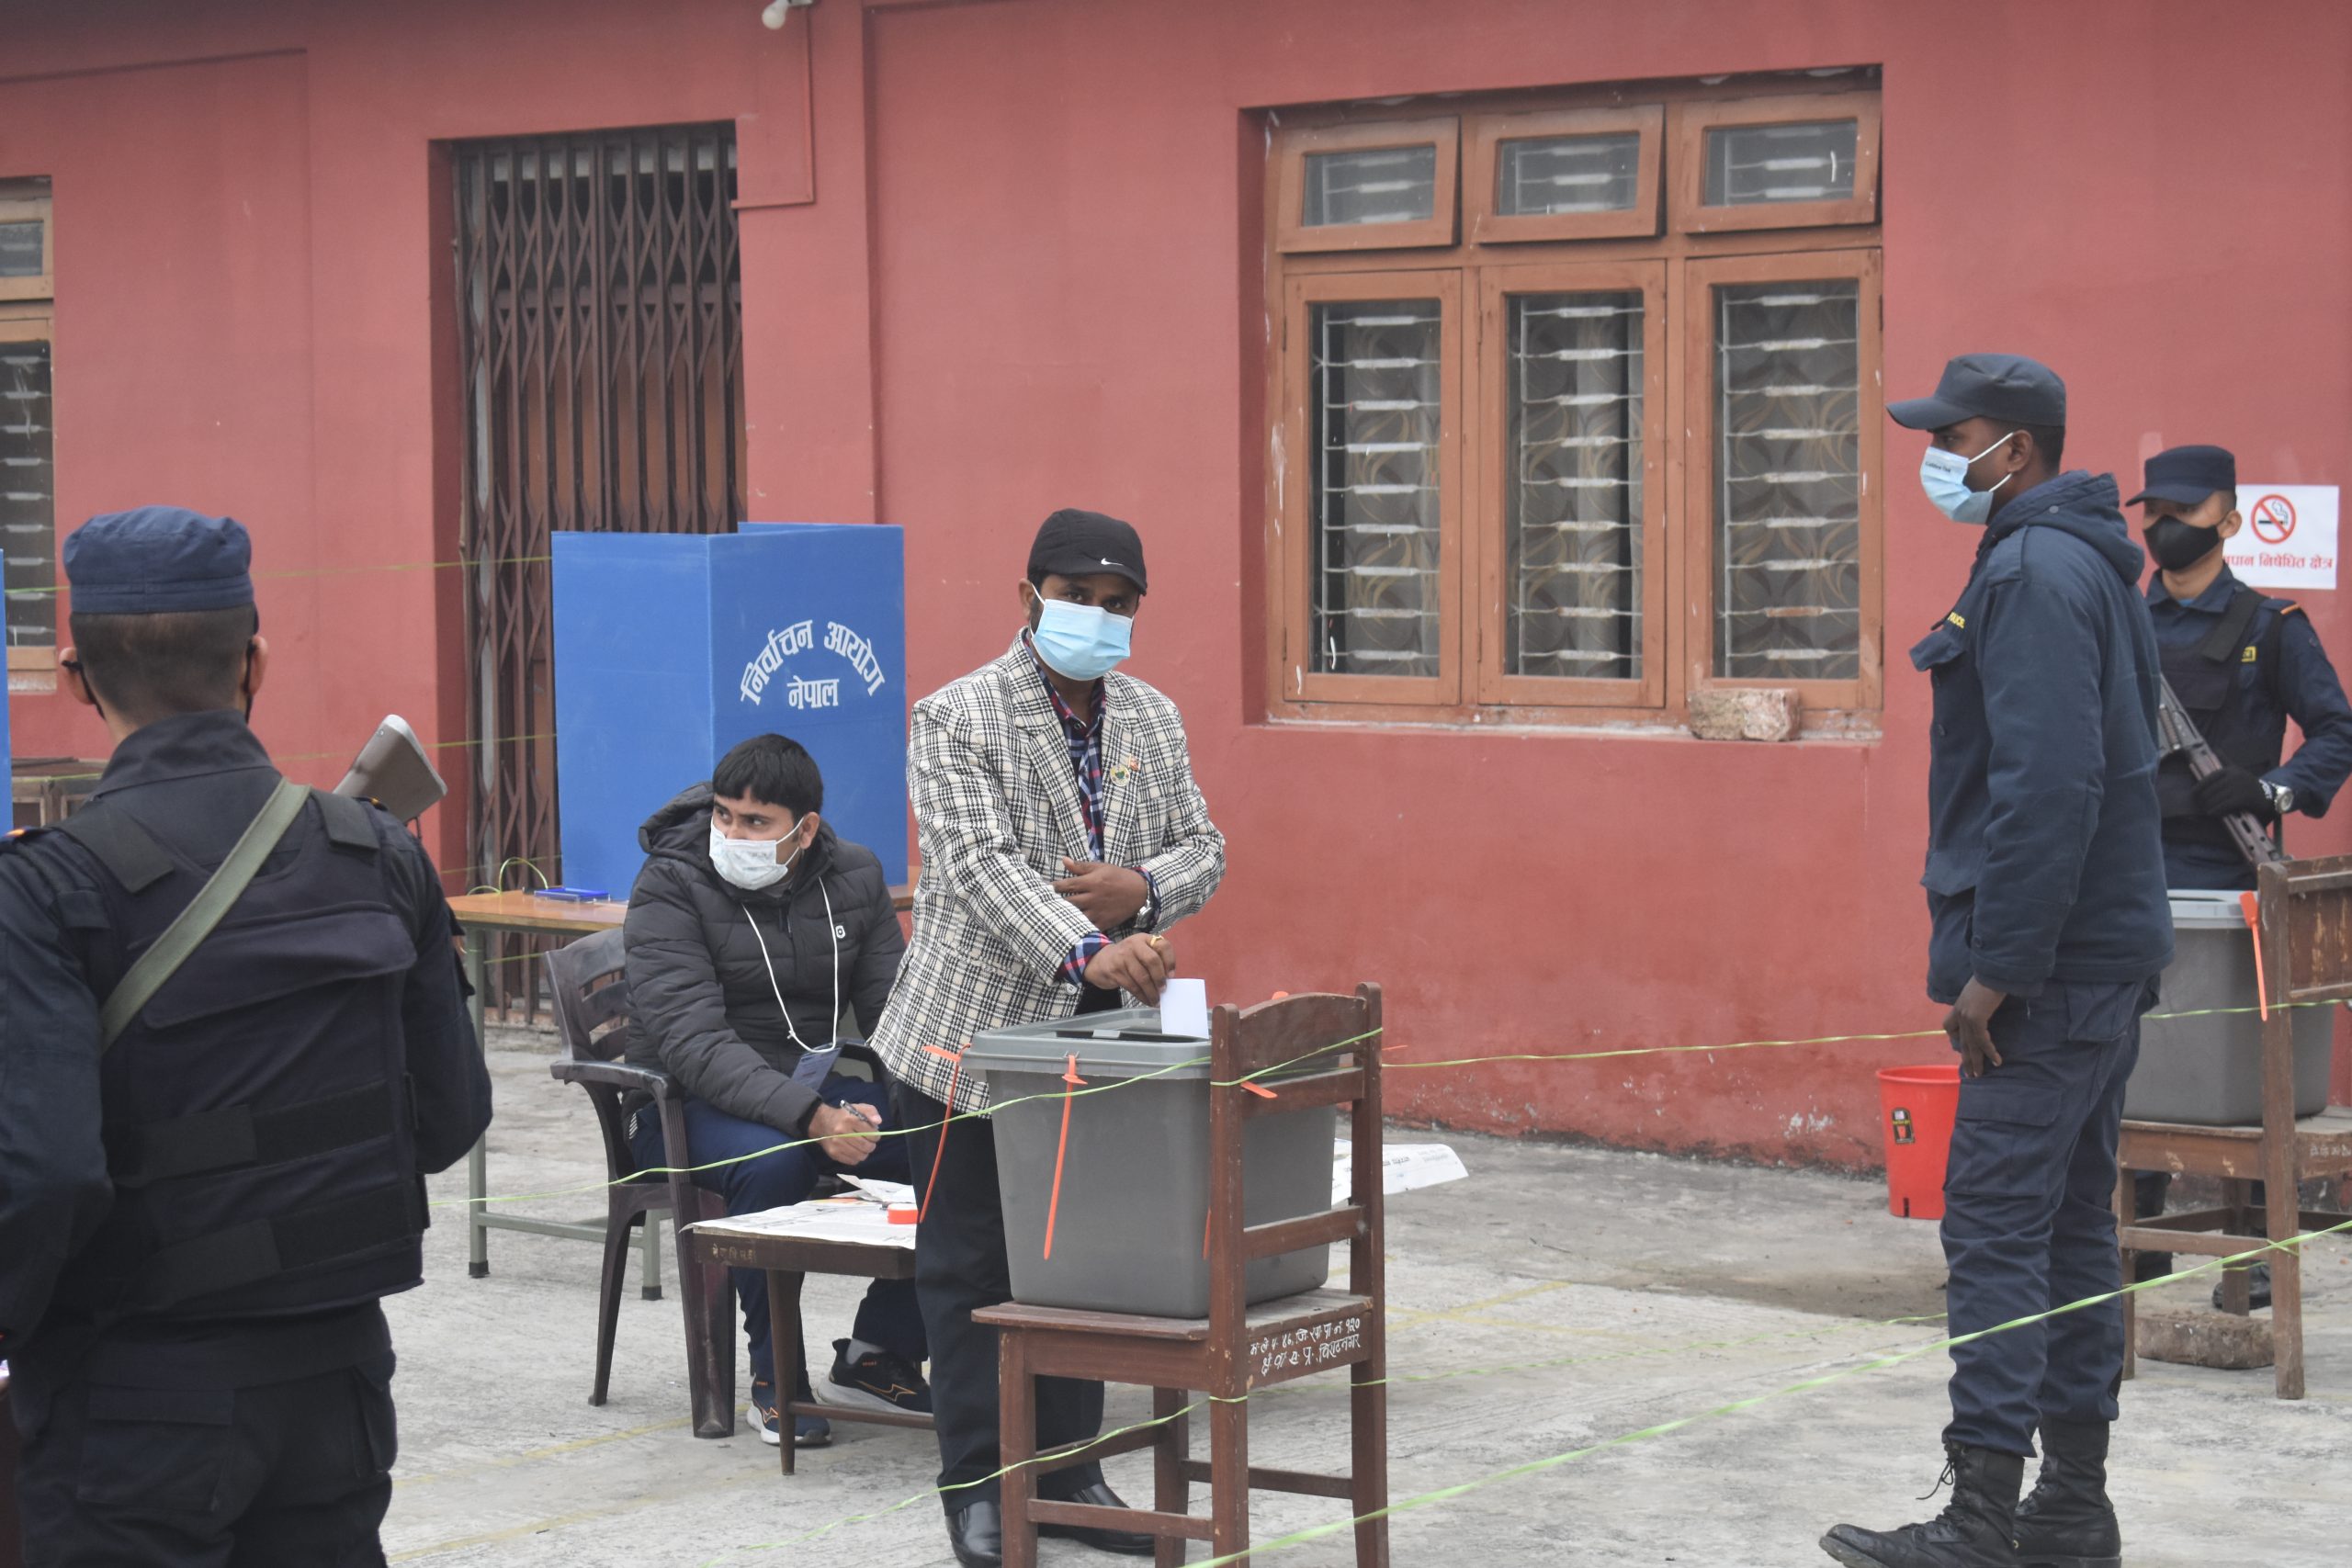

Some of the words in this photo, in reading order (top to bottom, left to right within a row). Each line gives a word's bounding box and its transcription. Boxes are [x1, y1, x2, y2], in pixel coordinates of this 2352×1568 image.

[741, 619, 814, 706] निर्वाचन
[824, 621, 886, 696] आयोग
[786, 675, 840, 710] नेपाल
